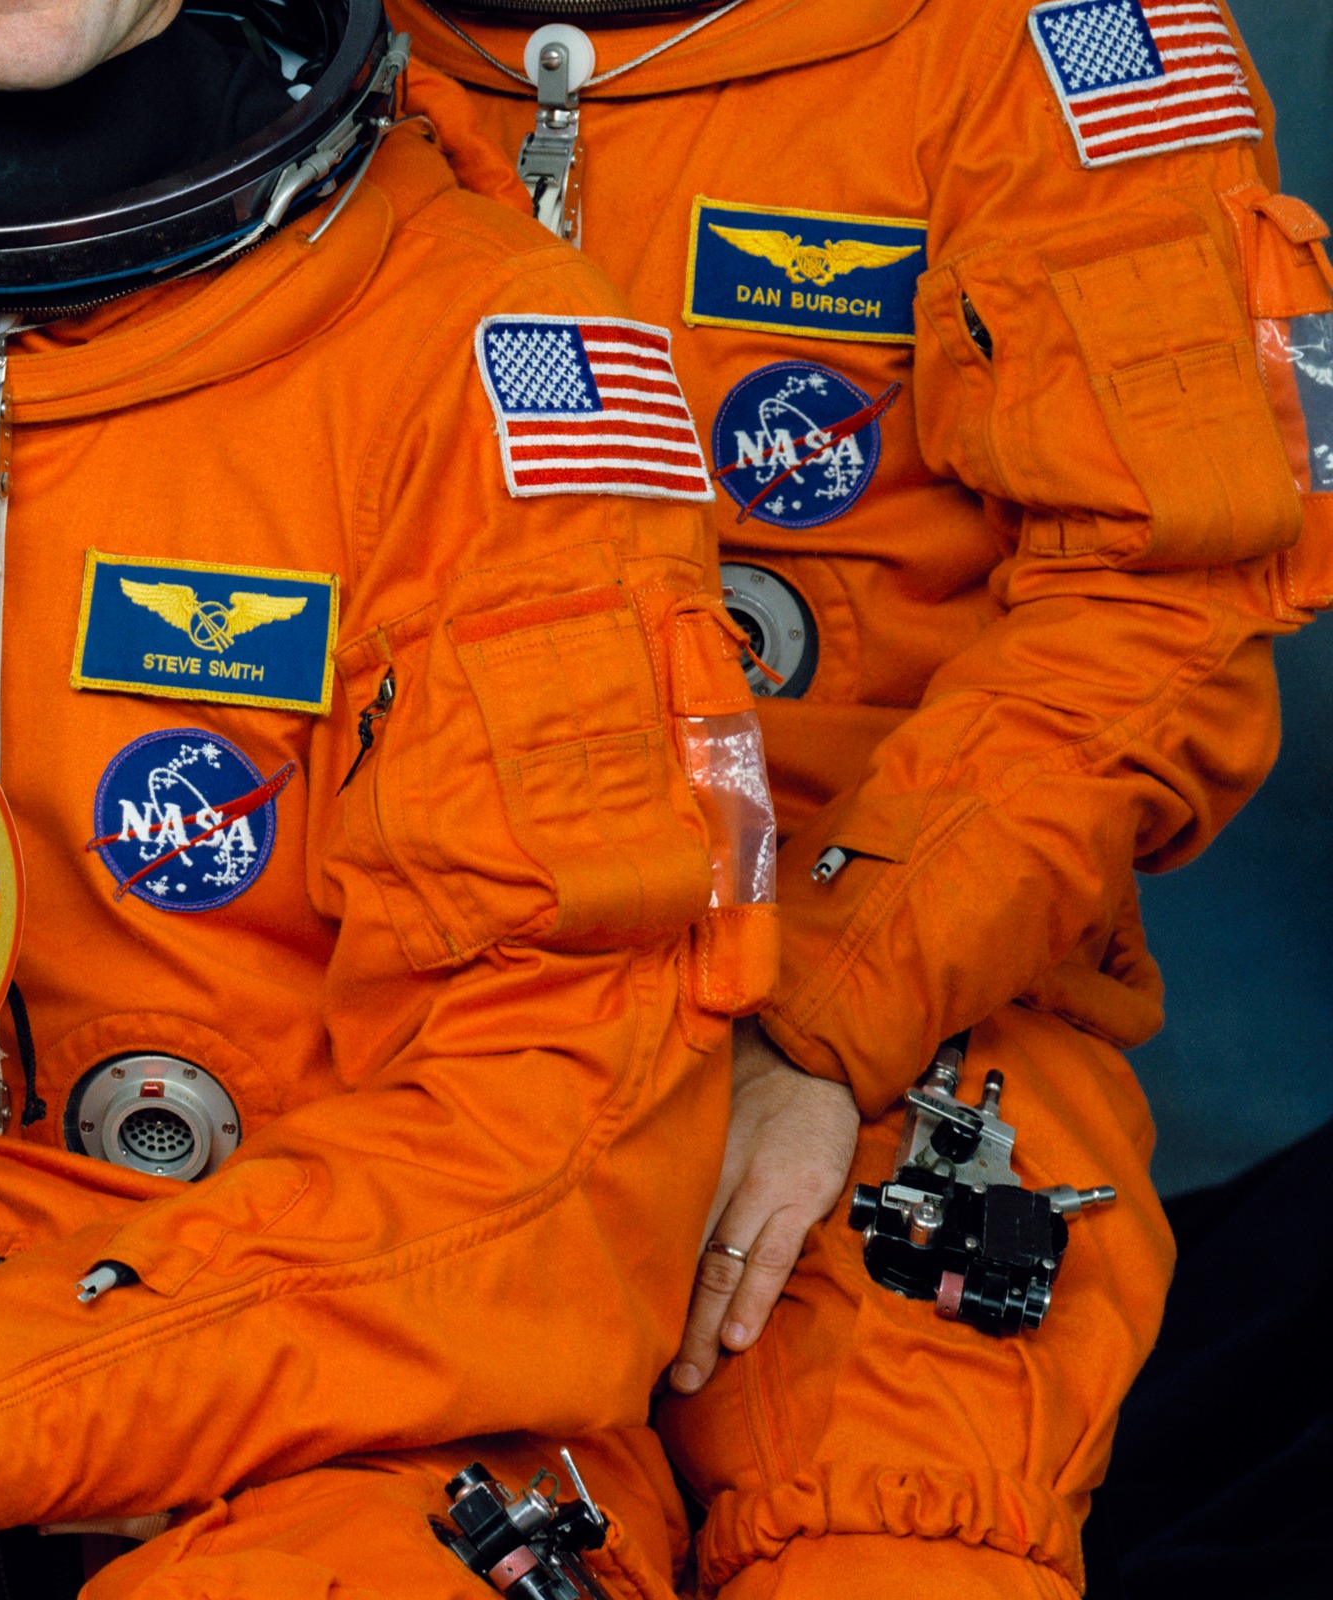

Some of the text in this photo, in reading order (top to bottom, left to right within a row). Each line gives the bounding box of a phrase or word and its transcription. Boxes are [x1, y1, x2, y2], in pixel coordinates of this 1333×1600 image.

[737, 285, 881, 319] DAN BURSCH
[734, 428, 865, 468] NASA
[143, 653, 265, 682] STEVE SMITH
[118, 799, 257, 852] NASA
